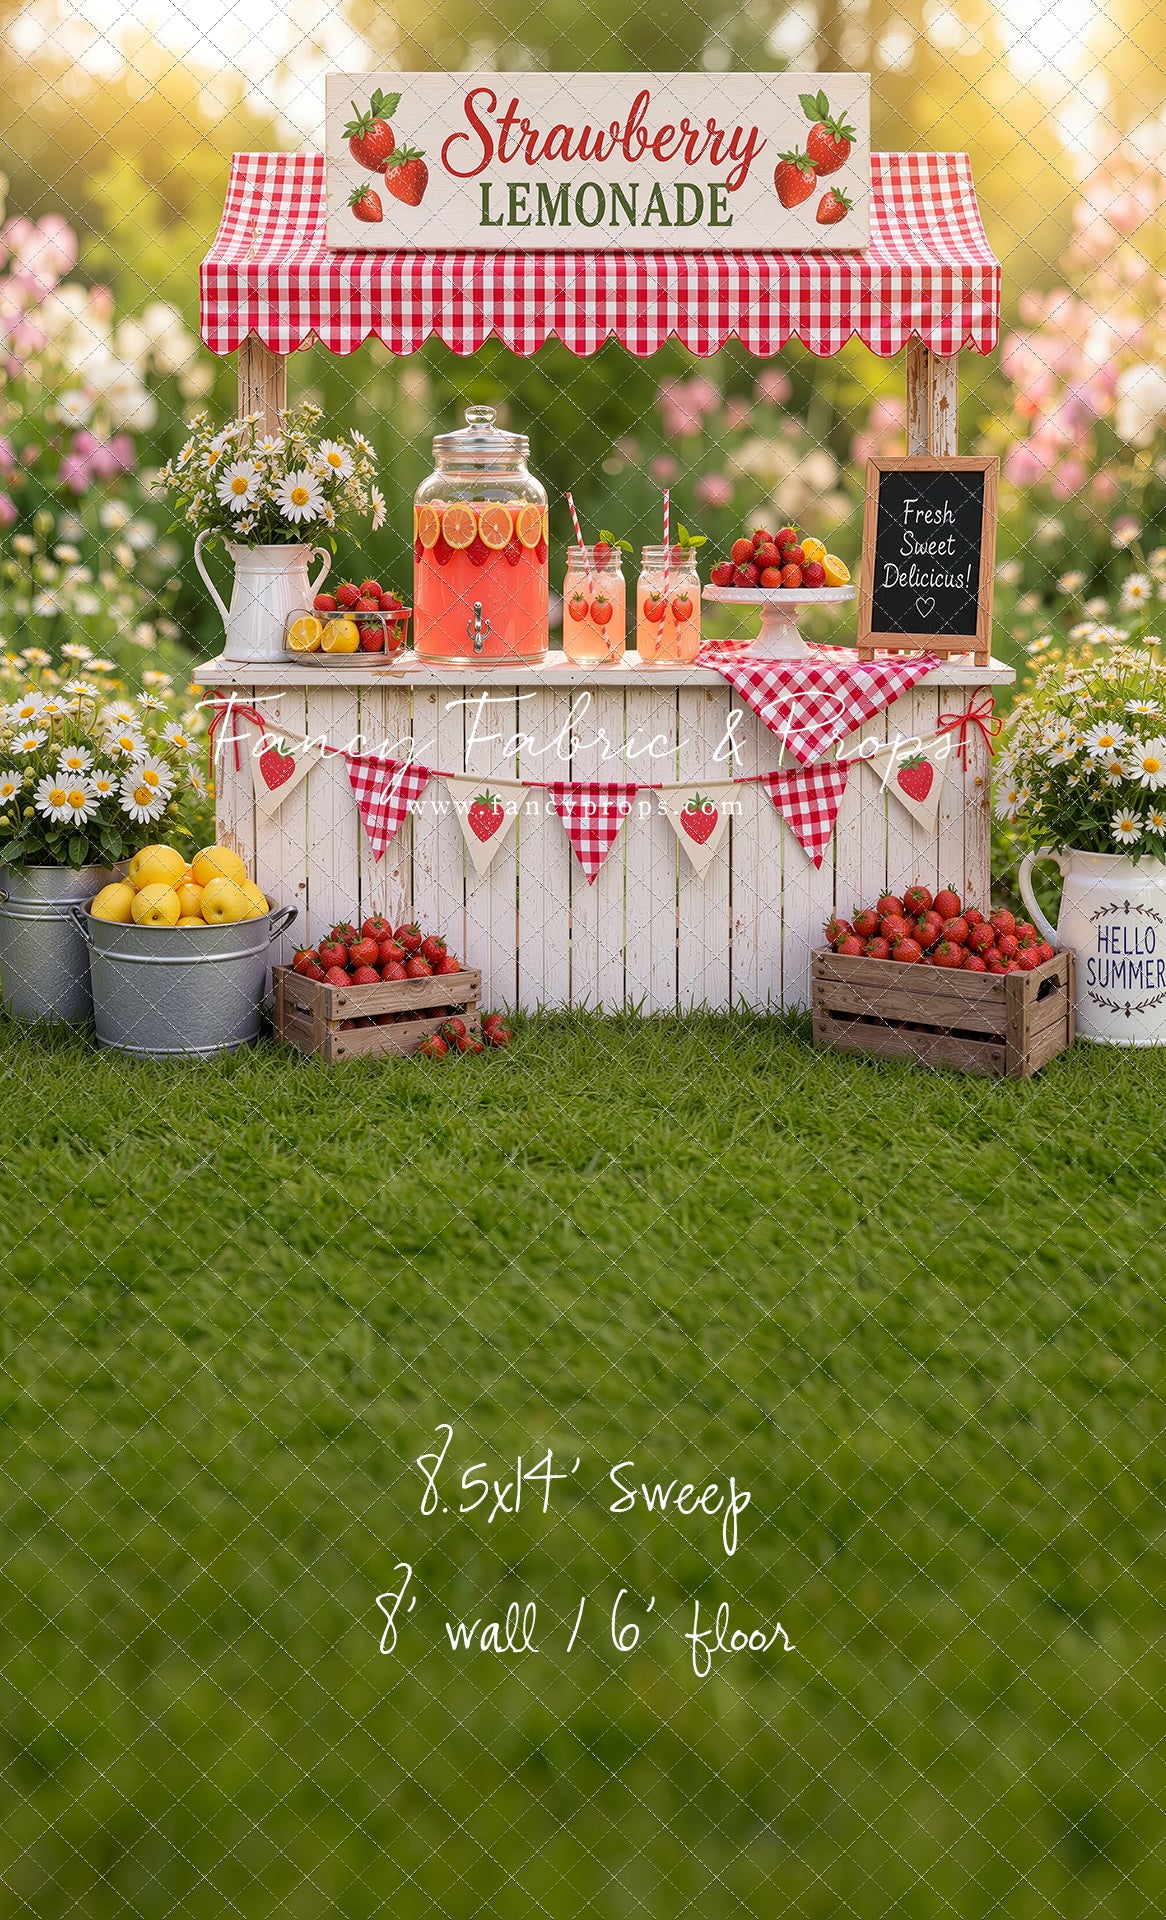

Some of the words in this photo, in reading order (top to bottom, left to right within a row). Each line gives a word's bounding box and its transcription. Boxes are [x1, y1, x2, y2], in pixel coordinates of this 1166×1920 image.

[441, 87, 767, 191] Strawberry
[478, 182, 734, 228] LEMONADE
[903, 499, 955, 525] Fresh
[900, 531, 956, 556] Sweet
[1097, 925, 1156, 955] HELLO
[1086, 957, 1166, 990] SUMMER
